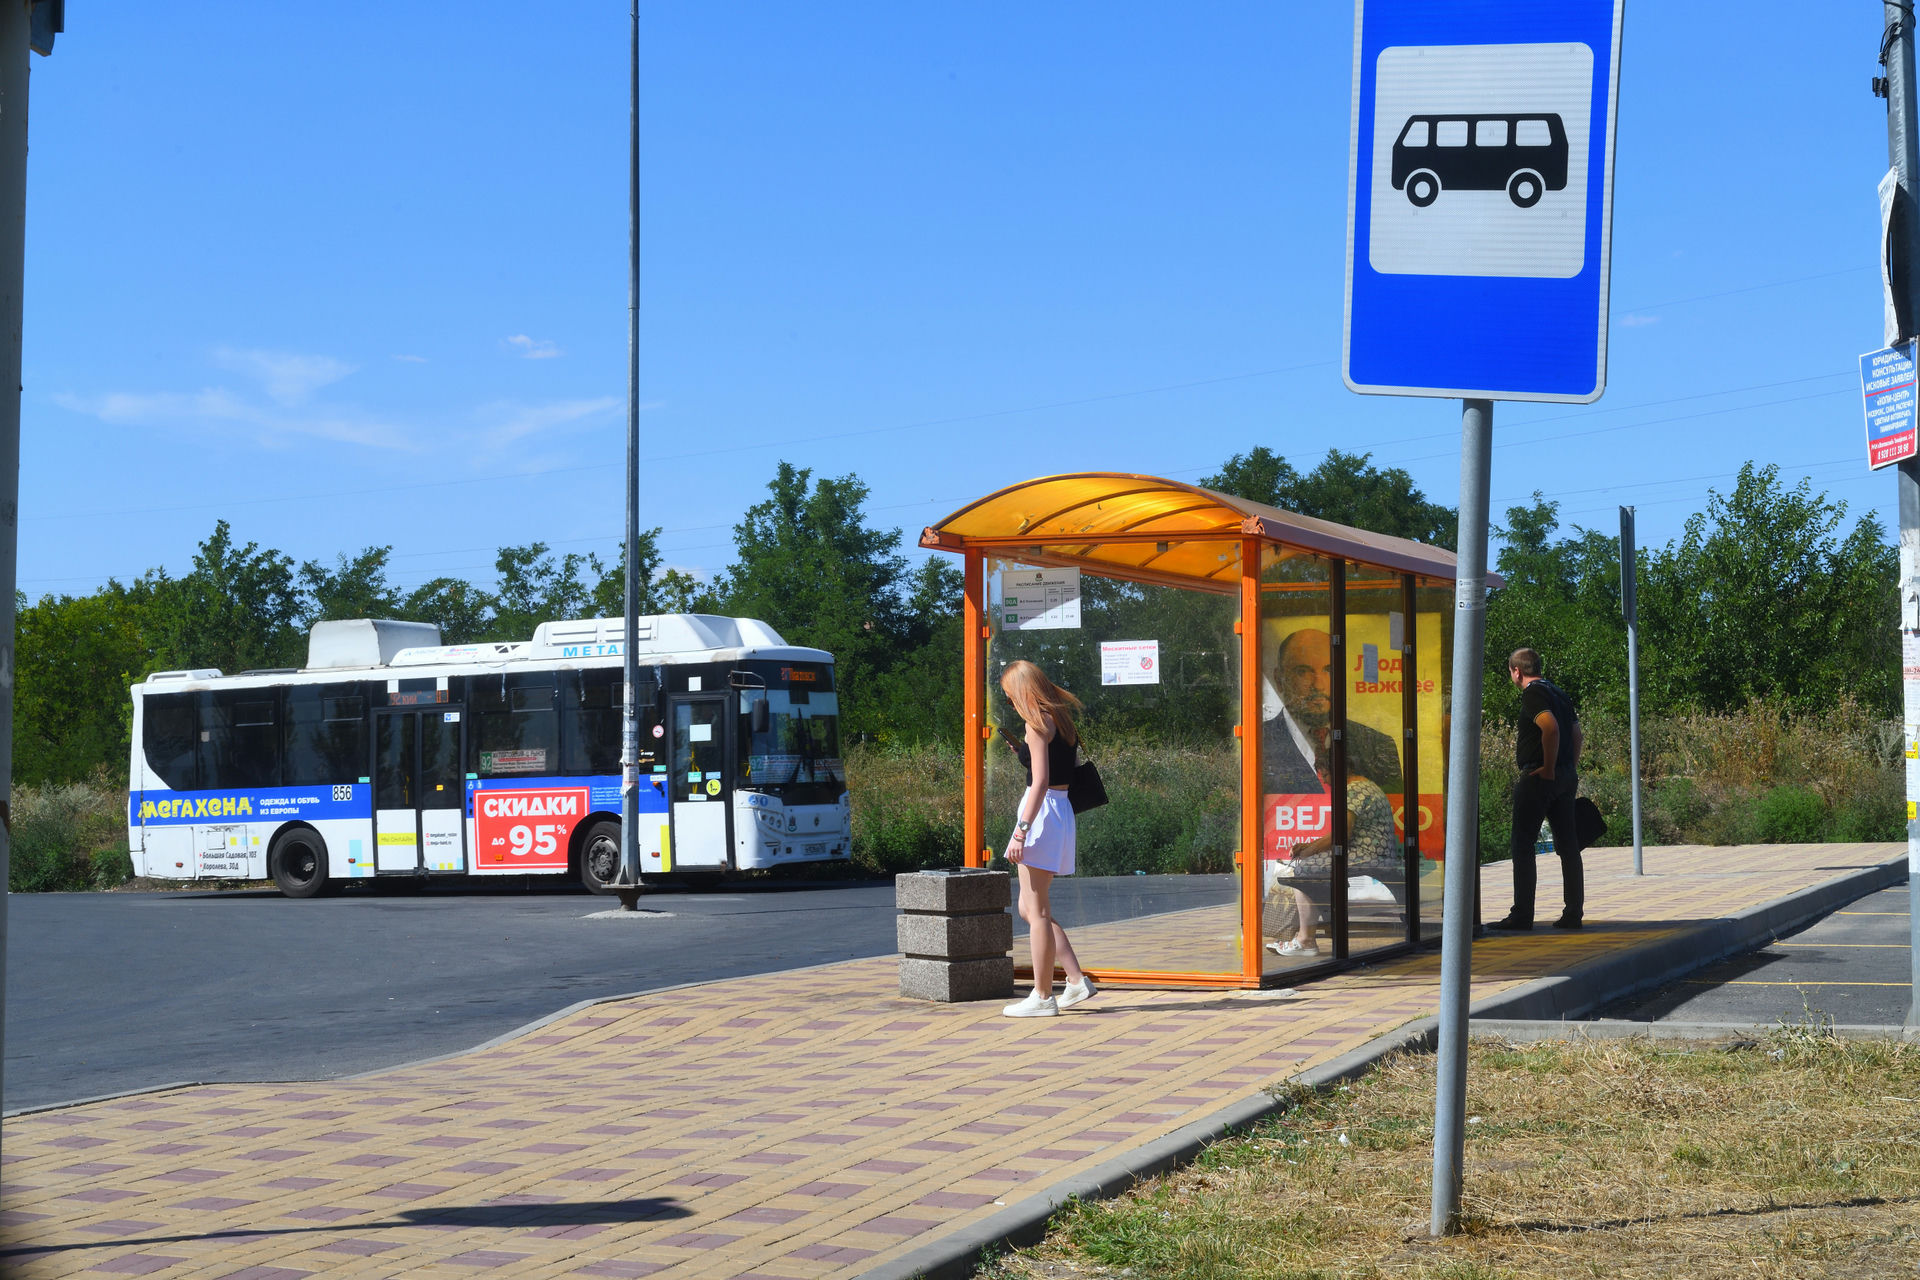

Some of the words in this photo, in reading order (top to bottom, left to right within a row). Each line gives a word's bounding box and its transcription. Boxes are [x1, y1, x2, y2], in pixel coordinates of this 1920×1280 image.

[563, 644, 626, 657] МЕТА
[481, 756, 492, 770] 92
[332, 785, 352, 801] 856
[260, 798, 289, 806] ОДЕЖДА
[483, 796, 577, 818] СКИДКИ
[270, 807, 300, 815] ЕВРОПЫ
[225, 851, 248, 859] Садовая,
[249, 850, 257, 858] 103
[203, 862, 228, 871] Королева,
